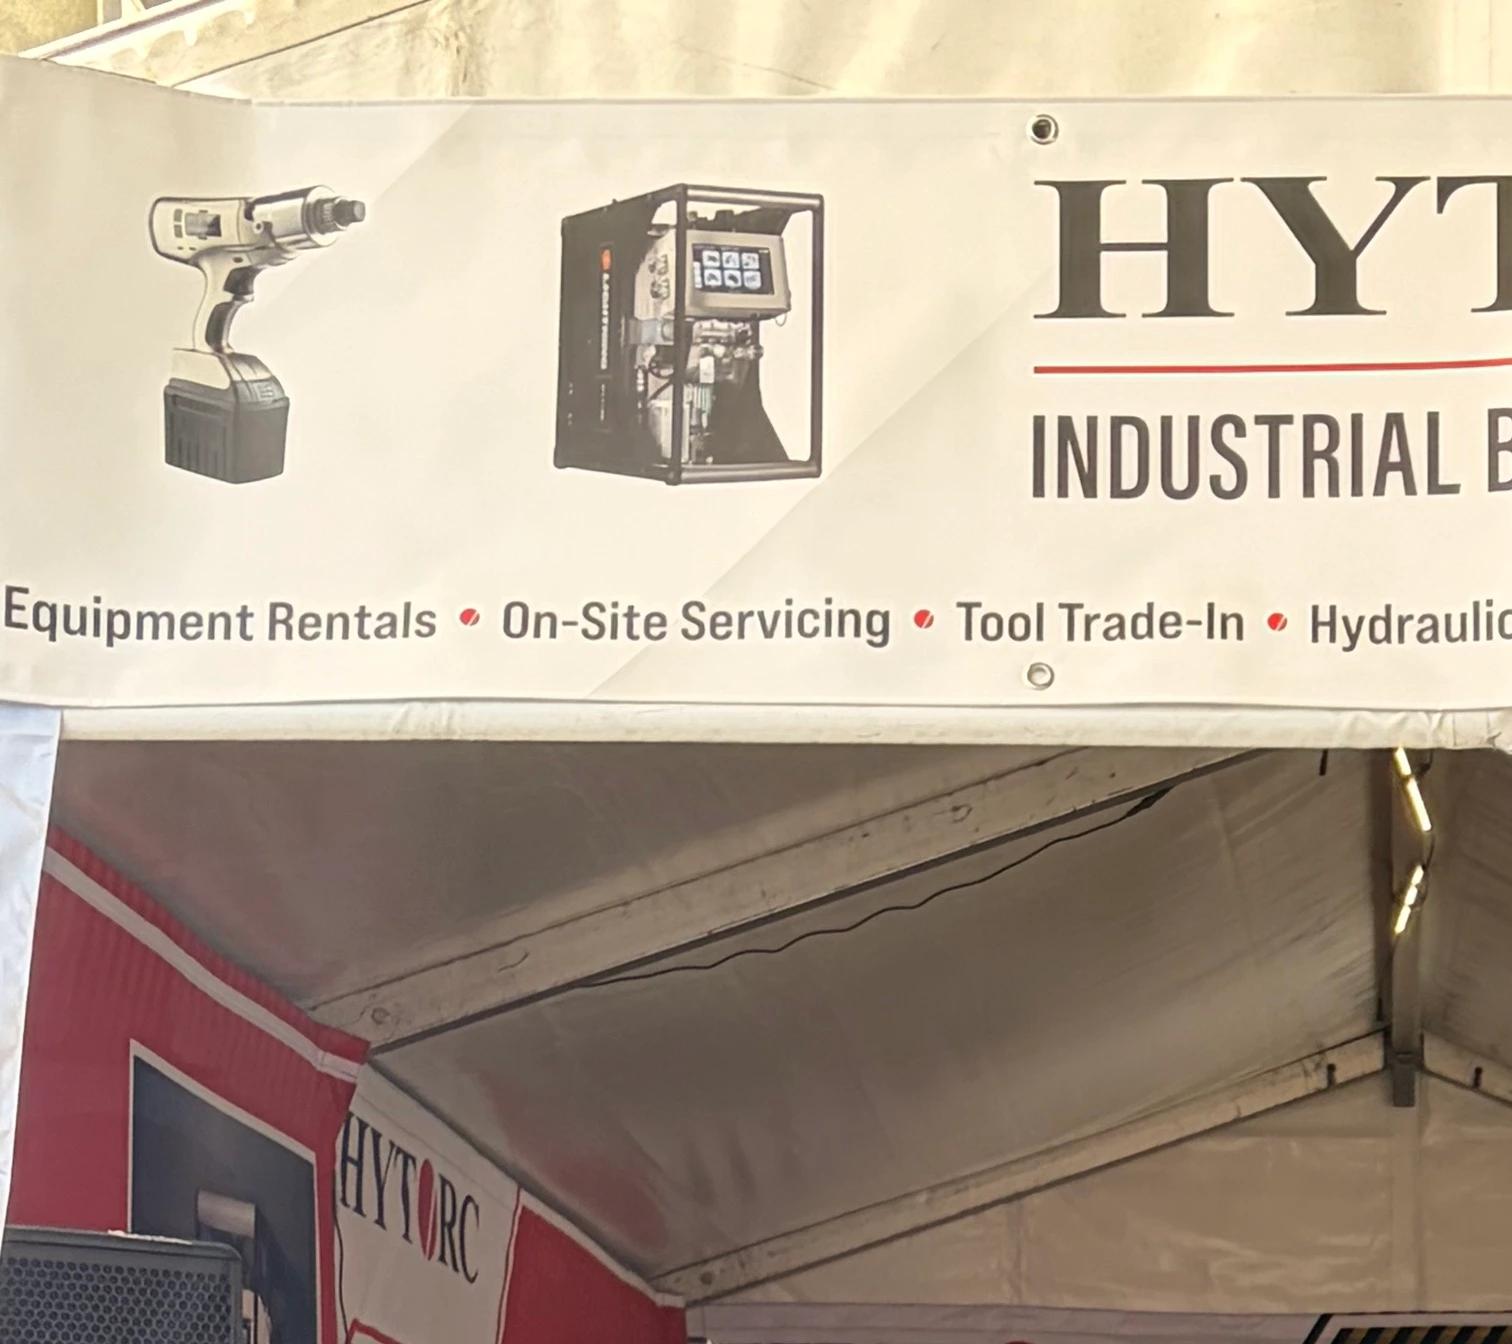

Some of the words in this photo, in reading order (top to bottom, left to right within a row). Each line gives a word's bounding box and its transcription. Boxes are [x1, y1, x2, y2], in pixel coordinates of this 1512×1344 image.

[1031, 412, 1460, 500] INDUSTRIAL
[3, 586, 254, 648] Equipment
[268, 602, 436, 641] Rentals
[502, 601, 667, 641] On-Site
[681, 598, 891, 648] Servicing
[957, 601, 1044, 643] Tool
[1063, 602, 1244, 642] Trade-In
[340, 1111, 479, 1284] HYTORC
